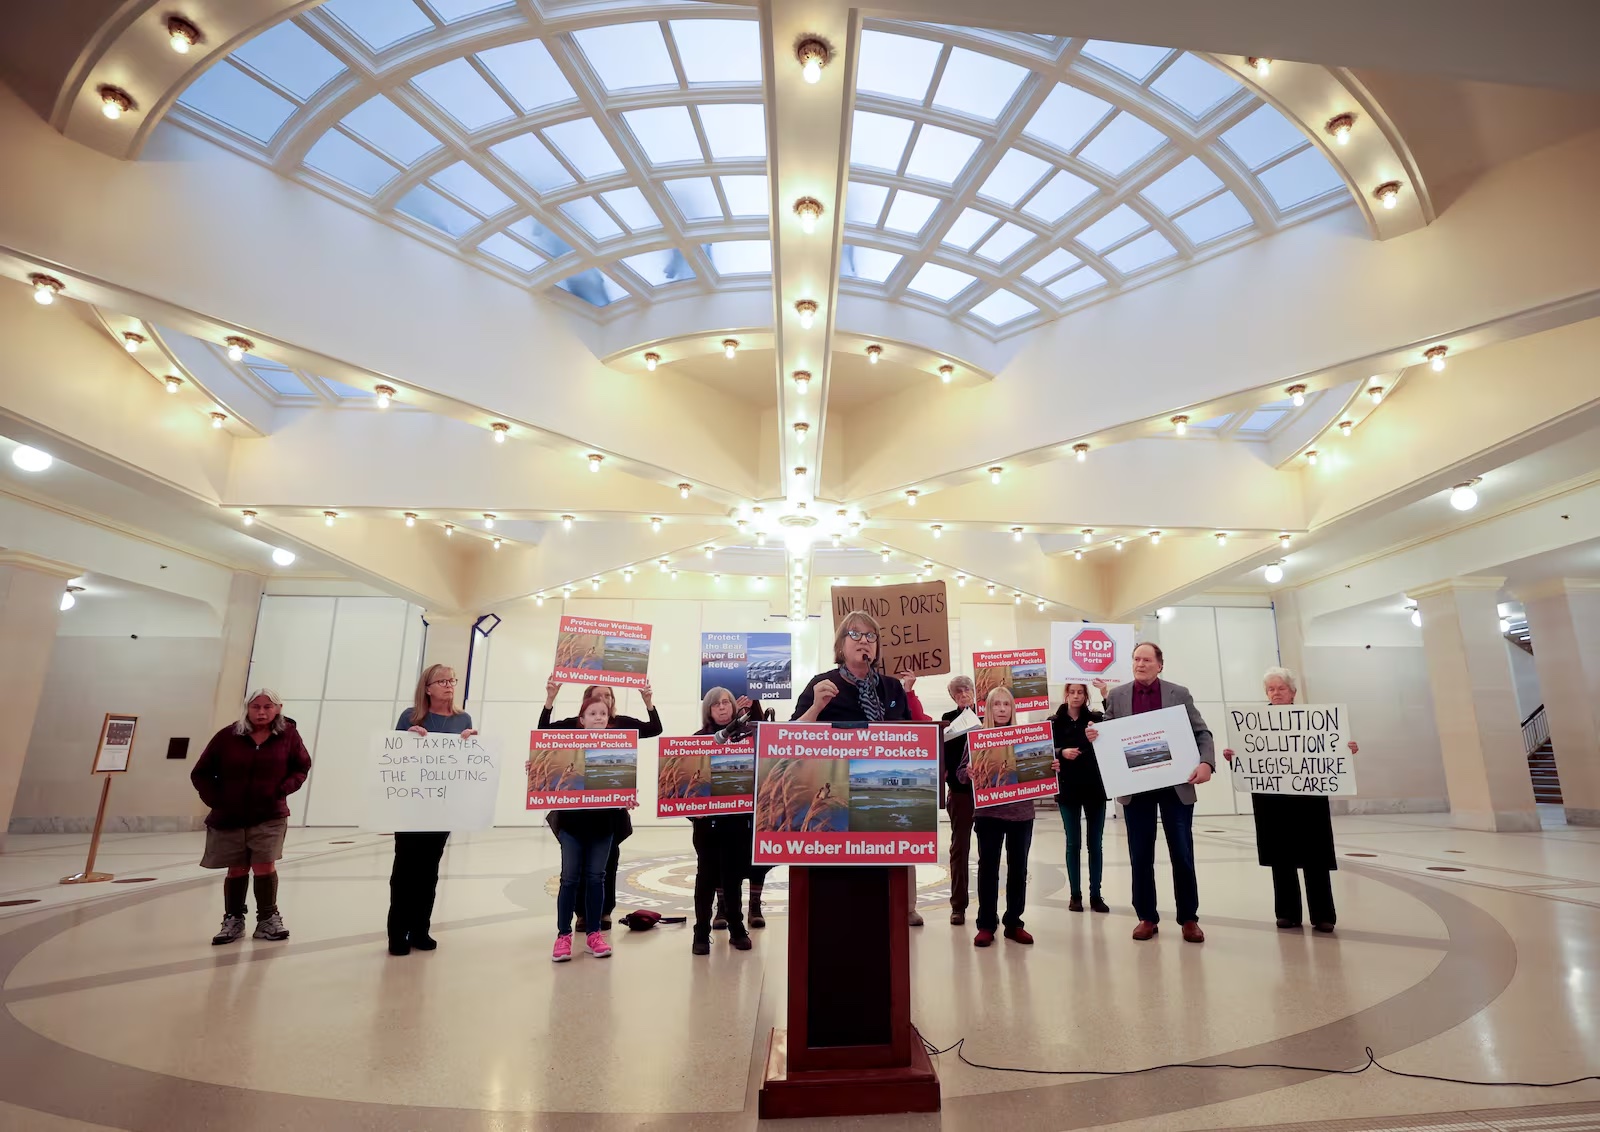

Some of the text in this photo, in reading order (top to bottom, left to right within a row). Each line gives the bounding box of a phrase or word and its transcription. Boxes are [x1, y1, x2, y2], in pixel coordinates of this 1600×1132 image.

[837, 593, 944, 616] INLAND PORTS
[570, 619, 597, 627] Protect
[611, 623, 642, 631] Wetlands
[619, 631, 647, 639] Pockets
[880, 624, 930, 646] ESEL
[1073, 640, 1112, 650] STOP
[894, 649, 942, 674] ZONES
[569, 672, 598, 680] Weber
[600, 675, 625, 683] Inland
[1231, 707, 1338, 731] POLLUTION
[778, 729, 918, 742] Protect our Wetlands
[1015, 726, 1043, 735] Wetlands
[385, 737, 484, 751] NO TAXPAYER
[1025, 734, 1048, 742] Pockets
[768, 745, 792, 756] Not
[875, 746, 928, 758] Pockets
[379, 754, 494, 768] SUBSIDIES FOR
[1234, 757, 1346, 775] A LEGISLATURE
[380, 768, 488, 782] THE POLLUTING
[990, 789, 1016, 800] Weber
[1017, 786, 1040, 795] Inland
[1041, 782, 1056, 791] Port
[1244, 776, 1338, 792] THAT CARES
[530, 796, 544, 805] No
[546, 796, 580, 804] Weber
[582, 794, 612, 803] Inland
[660, 804, 673, 812] No
[676, 803, 707, 811] Weber
[709, 801, 736, 809] Inland
[760, 840, 935, 854] No Weber Inland Port
